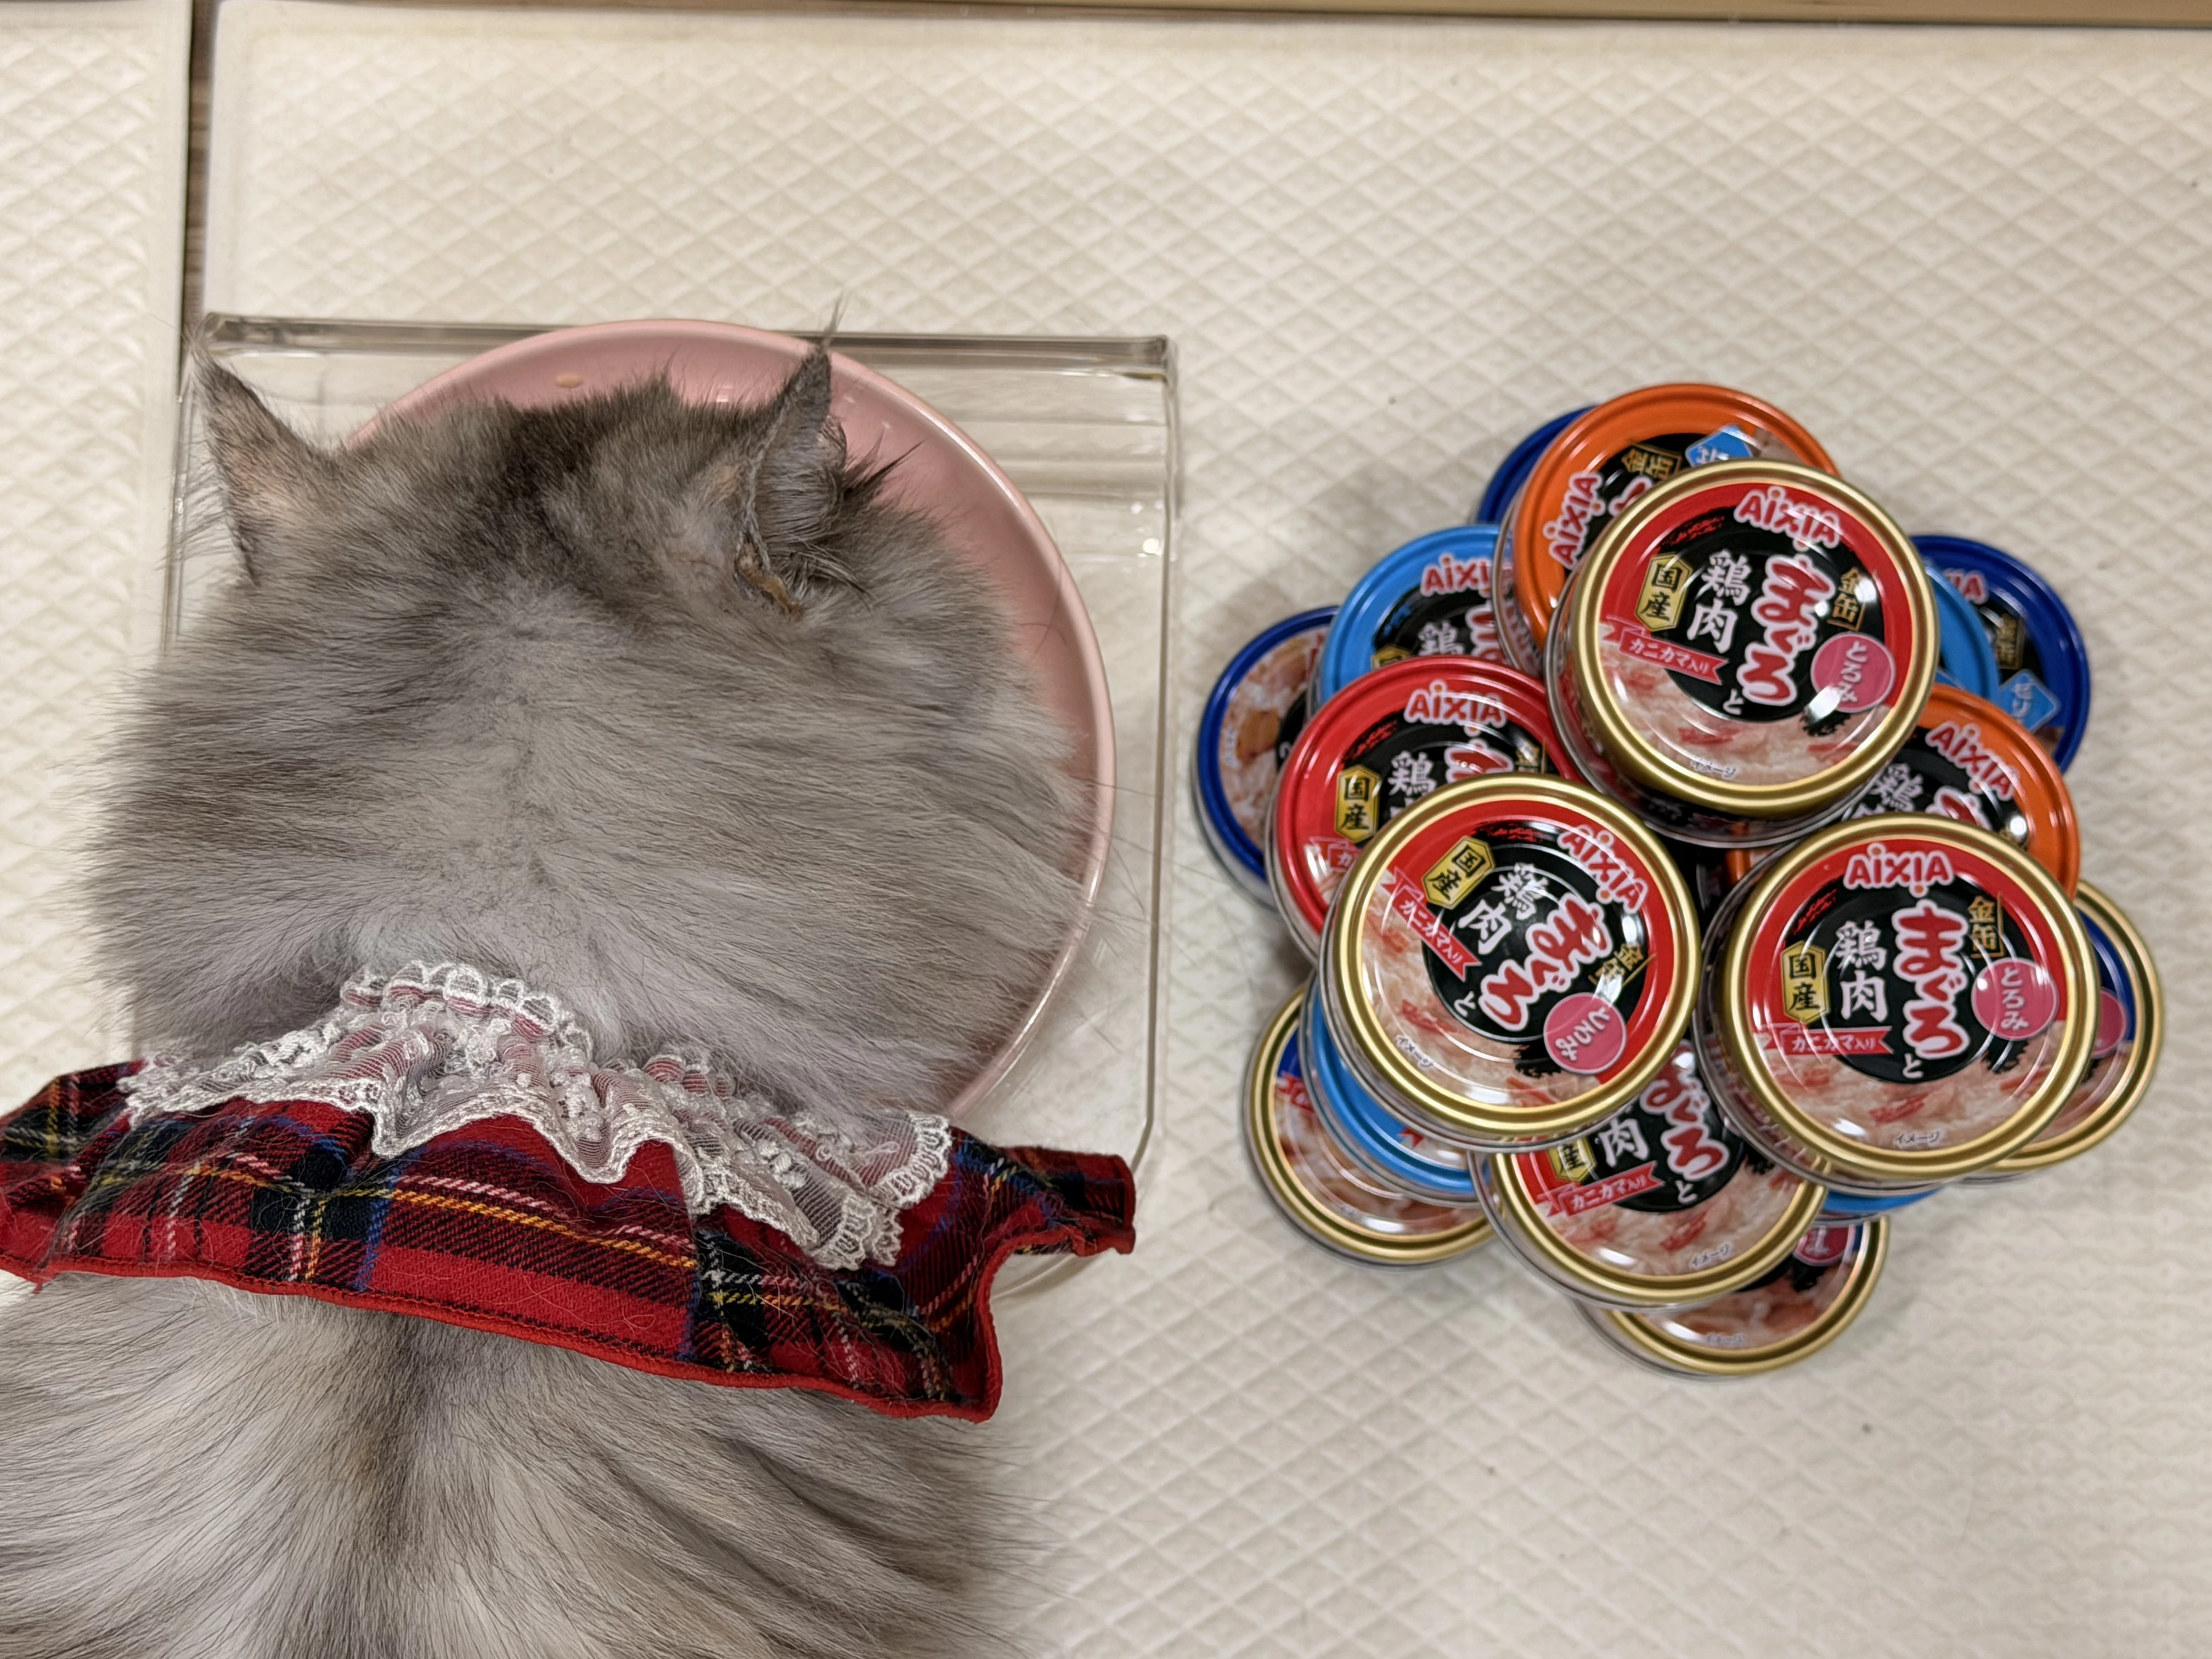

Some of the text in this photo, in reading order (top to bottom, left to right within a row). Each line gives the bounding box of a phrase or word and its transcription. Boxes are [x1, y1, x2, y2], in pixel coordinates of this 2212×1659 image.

[1639, 562, 1684, 622] 国産
[1687, 549, 1752, 653] 鶏肉
[1629, 637, 1709, 675] カニカマ入り
[1723, 555, 1835, 714] まぐろ と
[1840, 641, 1869, 703] とろみ
[1341, 777, 1370, 831] 国産
[1388, 749, 1436, 816] 鶏
[1427, 845, 1485, 900] 国産
[1399, 897, 1463, 967] カニカマ入り
[1458, 862, 1549, 955] 鶏肉
[1967, 895, 2000, 953] 金缶
[1454, 893, 1613, 1031] まぐろ と
[1788, 952, 1822, 1012] 国産
[1835, 920, 1888, 1021] 鶏肉
[1891, 900, 1970, 1078] まぐろ と
[2000, 966, 2029, 1032] とろみ
[1396, 1035, 1435, 1070] イメージ
[1555, 1007, 1611, 1062] とろみ
[1792, 1031, 1876, 1053] カニカマ入り
[1894, 1131, 1941, 1146] イメージ
[1572, 1175, 1646, 1210] カニカマ入り
[1675, 1180, 1697, 1204] と
[1690, 1242, 1731, 1270] イメージ
